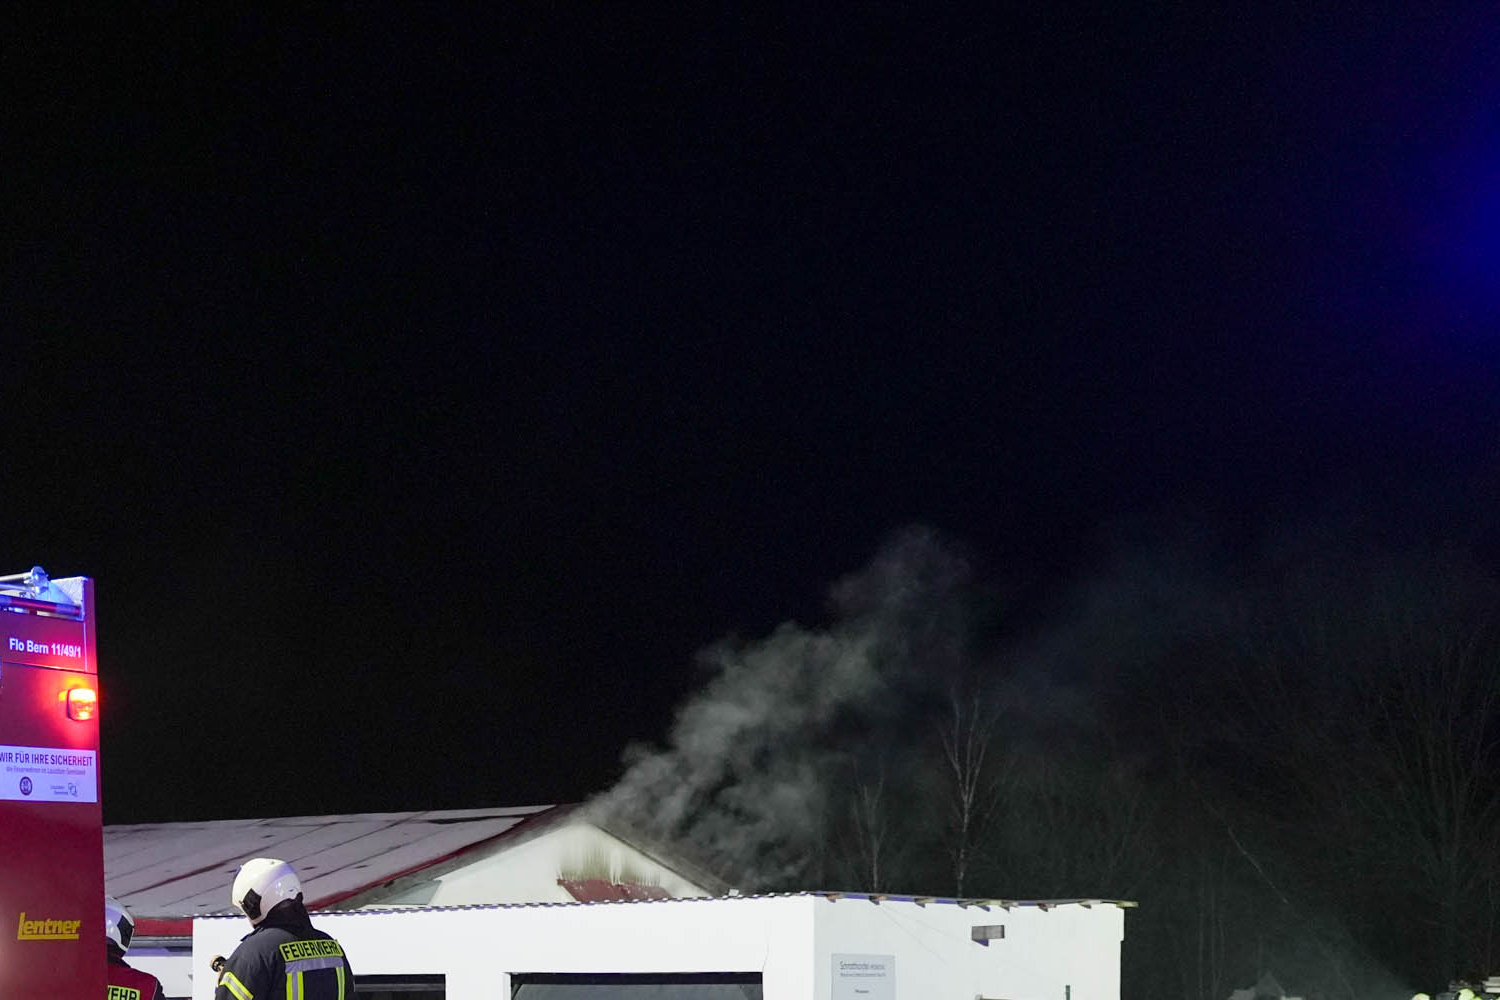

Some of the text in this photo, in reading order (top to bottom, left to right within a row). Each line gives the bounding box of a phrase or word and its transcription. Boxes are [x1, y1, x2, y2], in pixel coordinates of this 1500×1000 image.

[8, 637, 82, 658] Flo Bern 11/49/1
[15, 751, 30, 764] FÜR
[31, 754, 49, 765] IHRE
[50, 754, 93, 767] SICHERHEIT
[17, 911, 81, 941] lentner
[282, 941, 341, 961] FEUERWEHR
